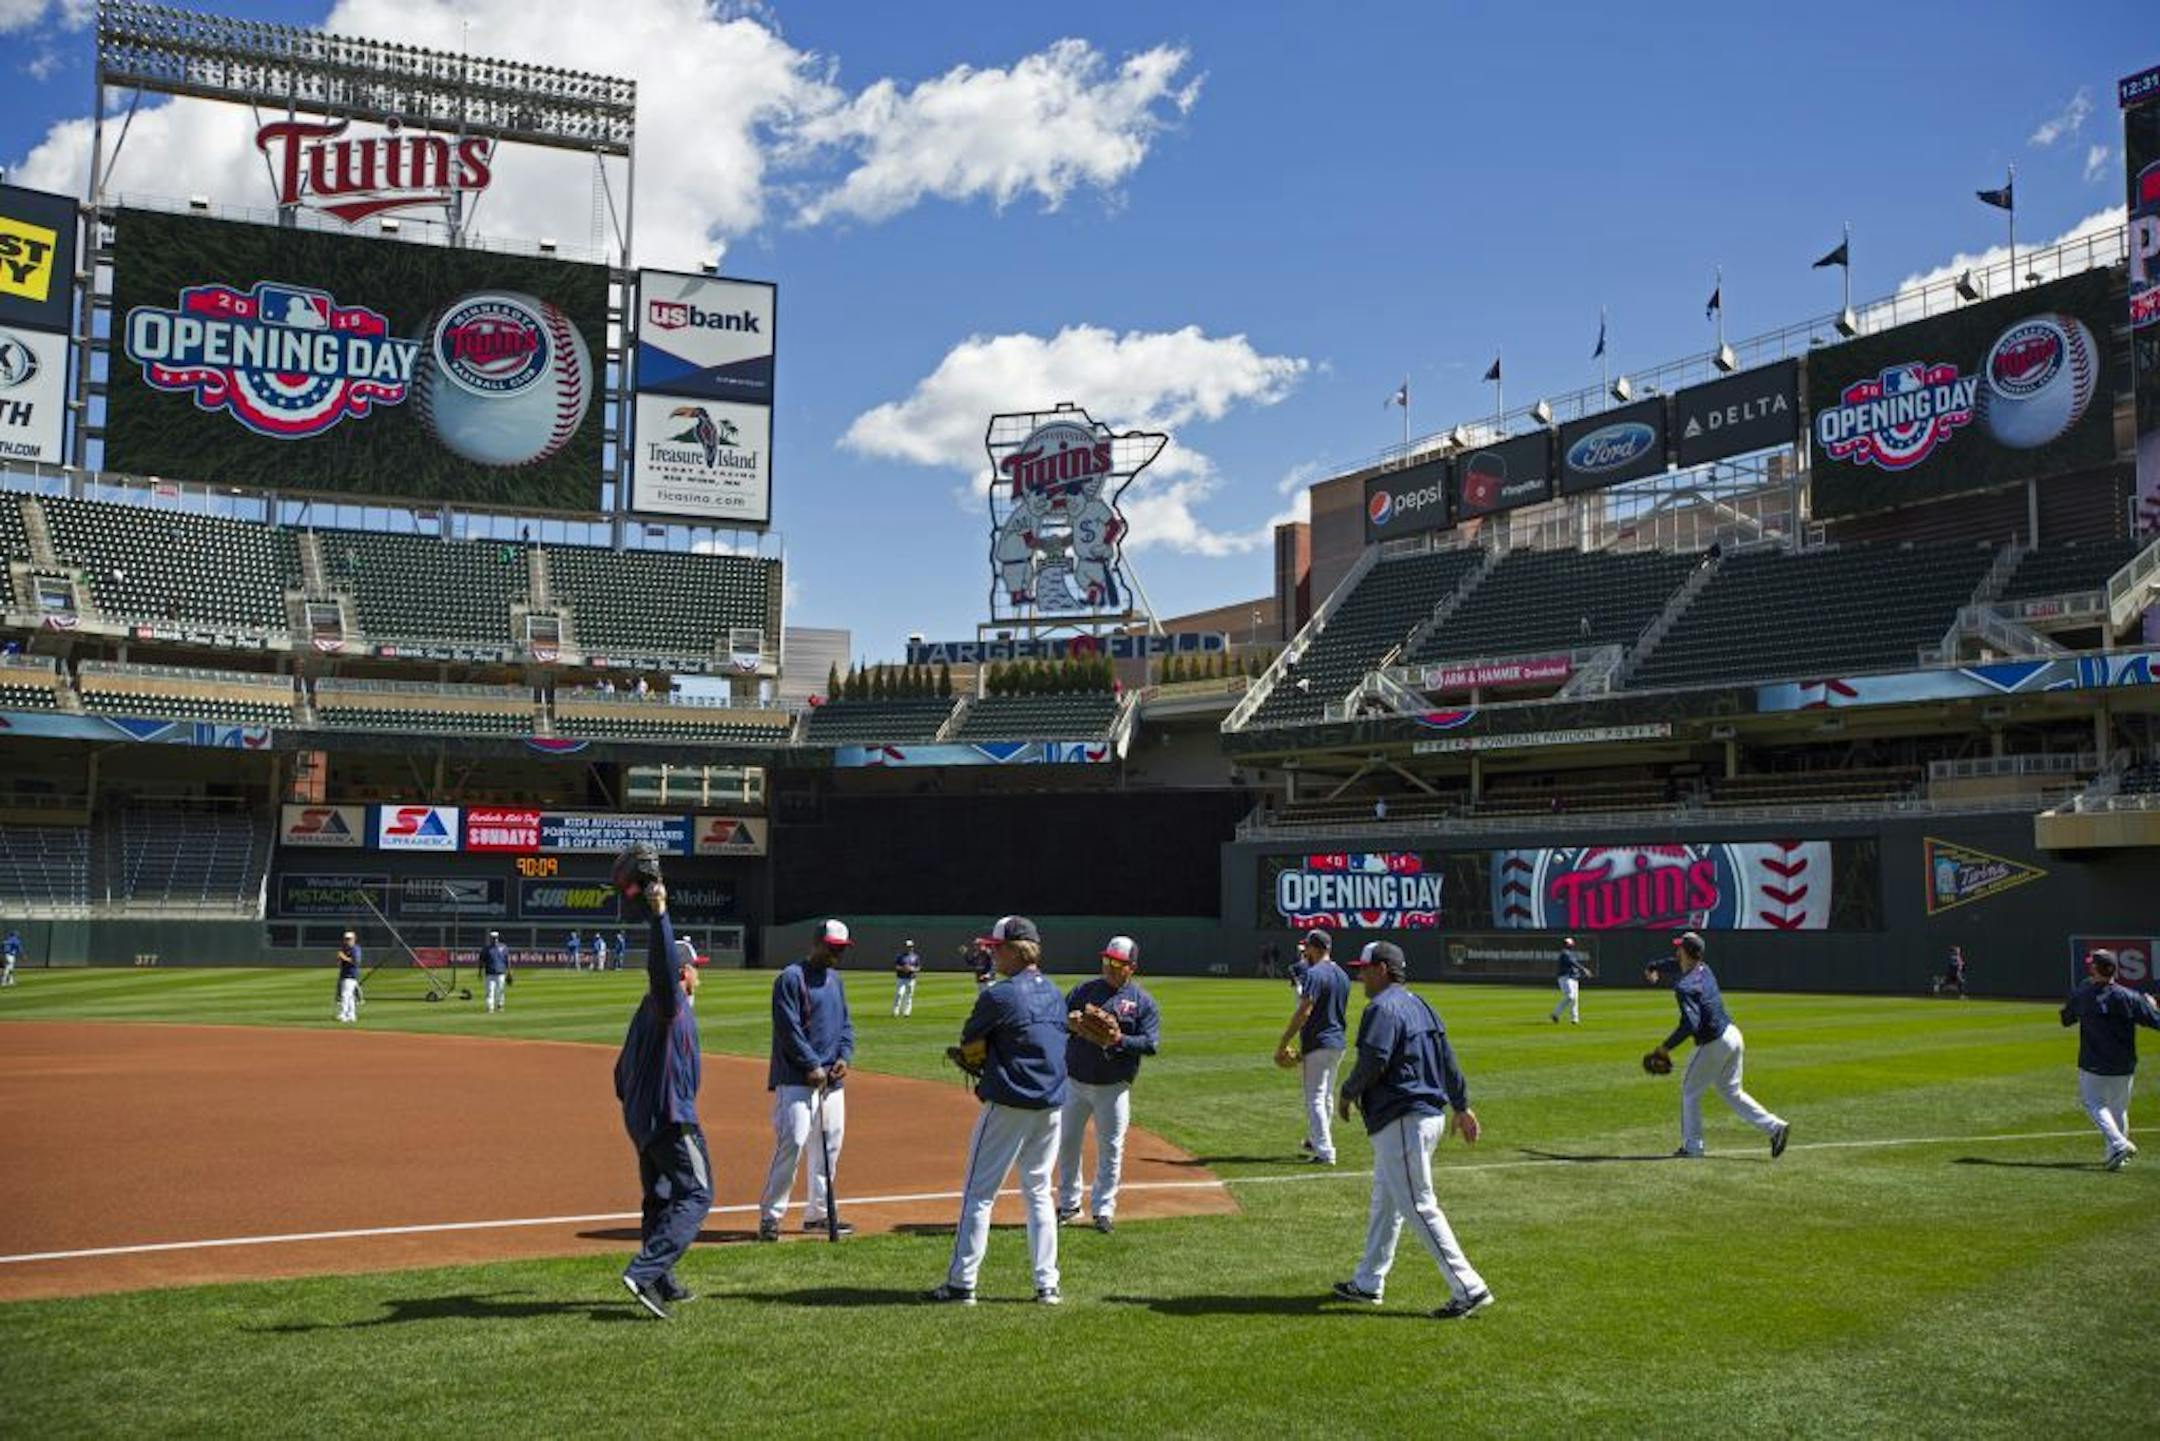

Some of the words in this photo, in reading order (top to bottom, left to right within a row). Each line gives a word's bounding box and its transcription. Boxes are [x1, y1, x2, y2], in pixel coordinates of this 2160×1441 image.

[255, 116, 492, 206] Twins
[133, 312, 341, 375] OPENING
[346, 338, 419, 381] DAY
[446, 318, 538, 365] Twins
[1708, 392, 1789, 431] DELTA
[1820, 389, 1933, 443] OPENING
[1935, 378, 1979, 414] DAY
[648, 442, 704, 465] Treasure
[718, 449, 759, 470] Island
[1582, 431, 1638, 466] Ford
[1000, 440, 1114, 501] Twins
[1394, 479, 1443, 517] pepsi
[909, 640, 1061, 665] TARGET
[1106, 632, 1231, 659] FIELD
[1444, 671, 1465, 686] ARM
[1468, 669, 1476, 683] &
[1478, 666, 1521, 683] HAMMER
[469, 827, 538, 846] SUNDAYS
[542, 826, 601, 839] POSTGAME
[603, 828, 627, 839] RUN
[628, 829, 650, 840] THE
[563, 817, 589, 828] KIDS
[591, 818, 664, 830] AUTOGRAPHS
[573, 838, 593, 849] OFF
[516, 857, 558, 877] 90:09
[1958, 862, 2011, 886] Twins
[526, 886, 616, 909] SUBWAY
[1281, 872, 1399, 910] OPENING
[1402, 873, 1445, 909] DAY
[1550, 858, 1719, 930] Twins
